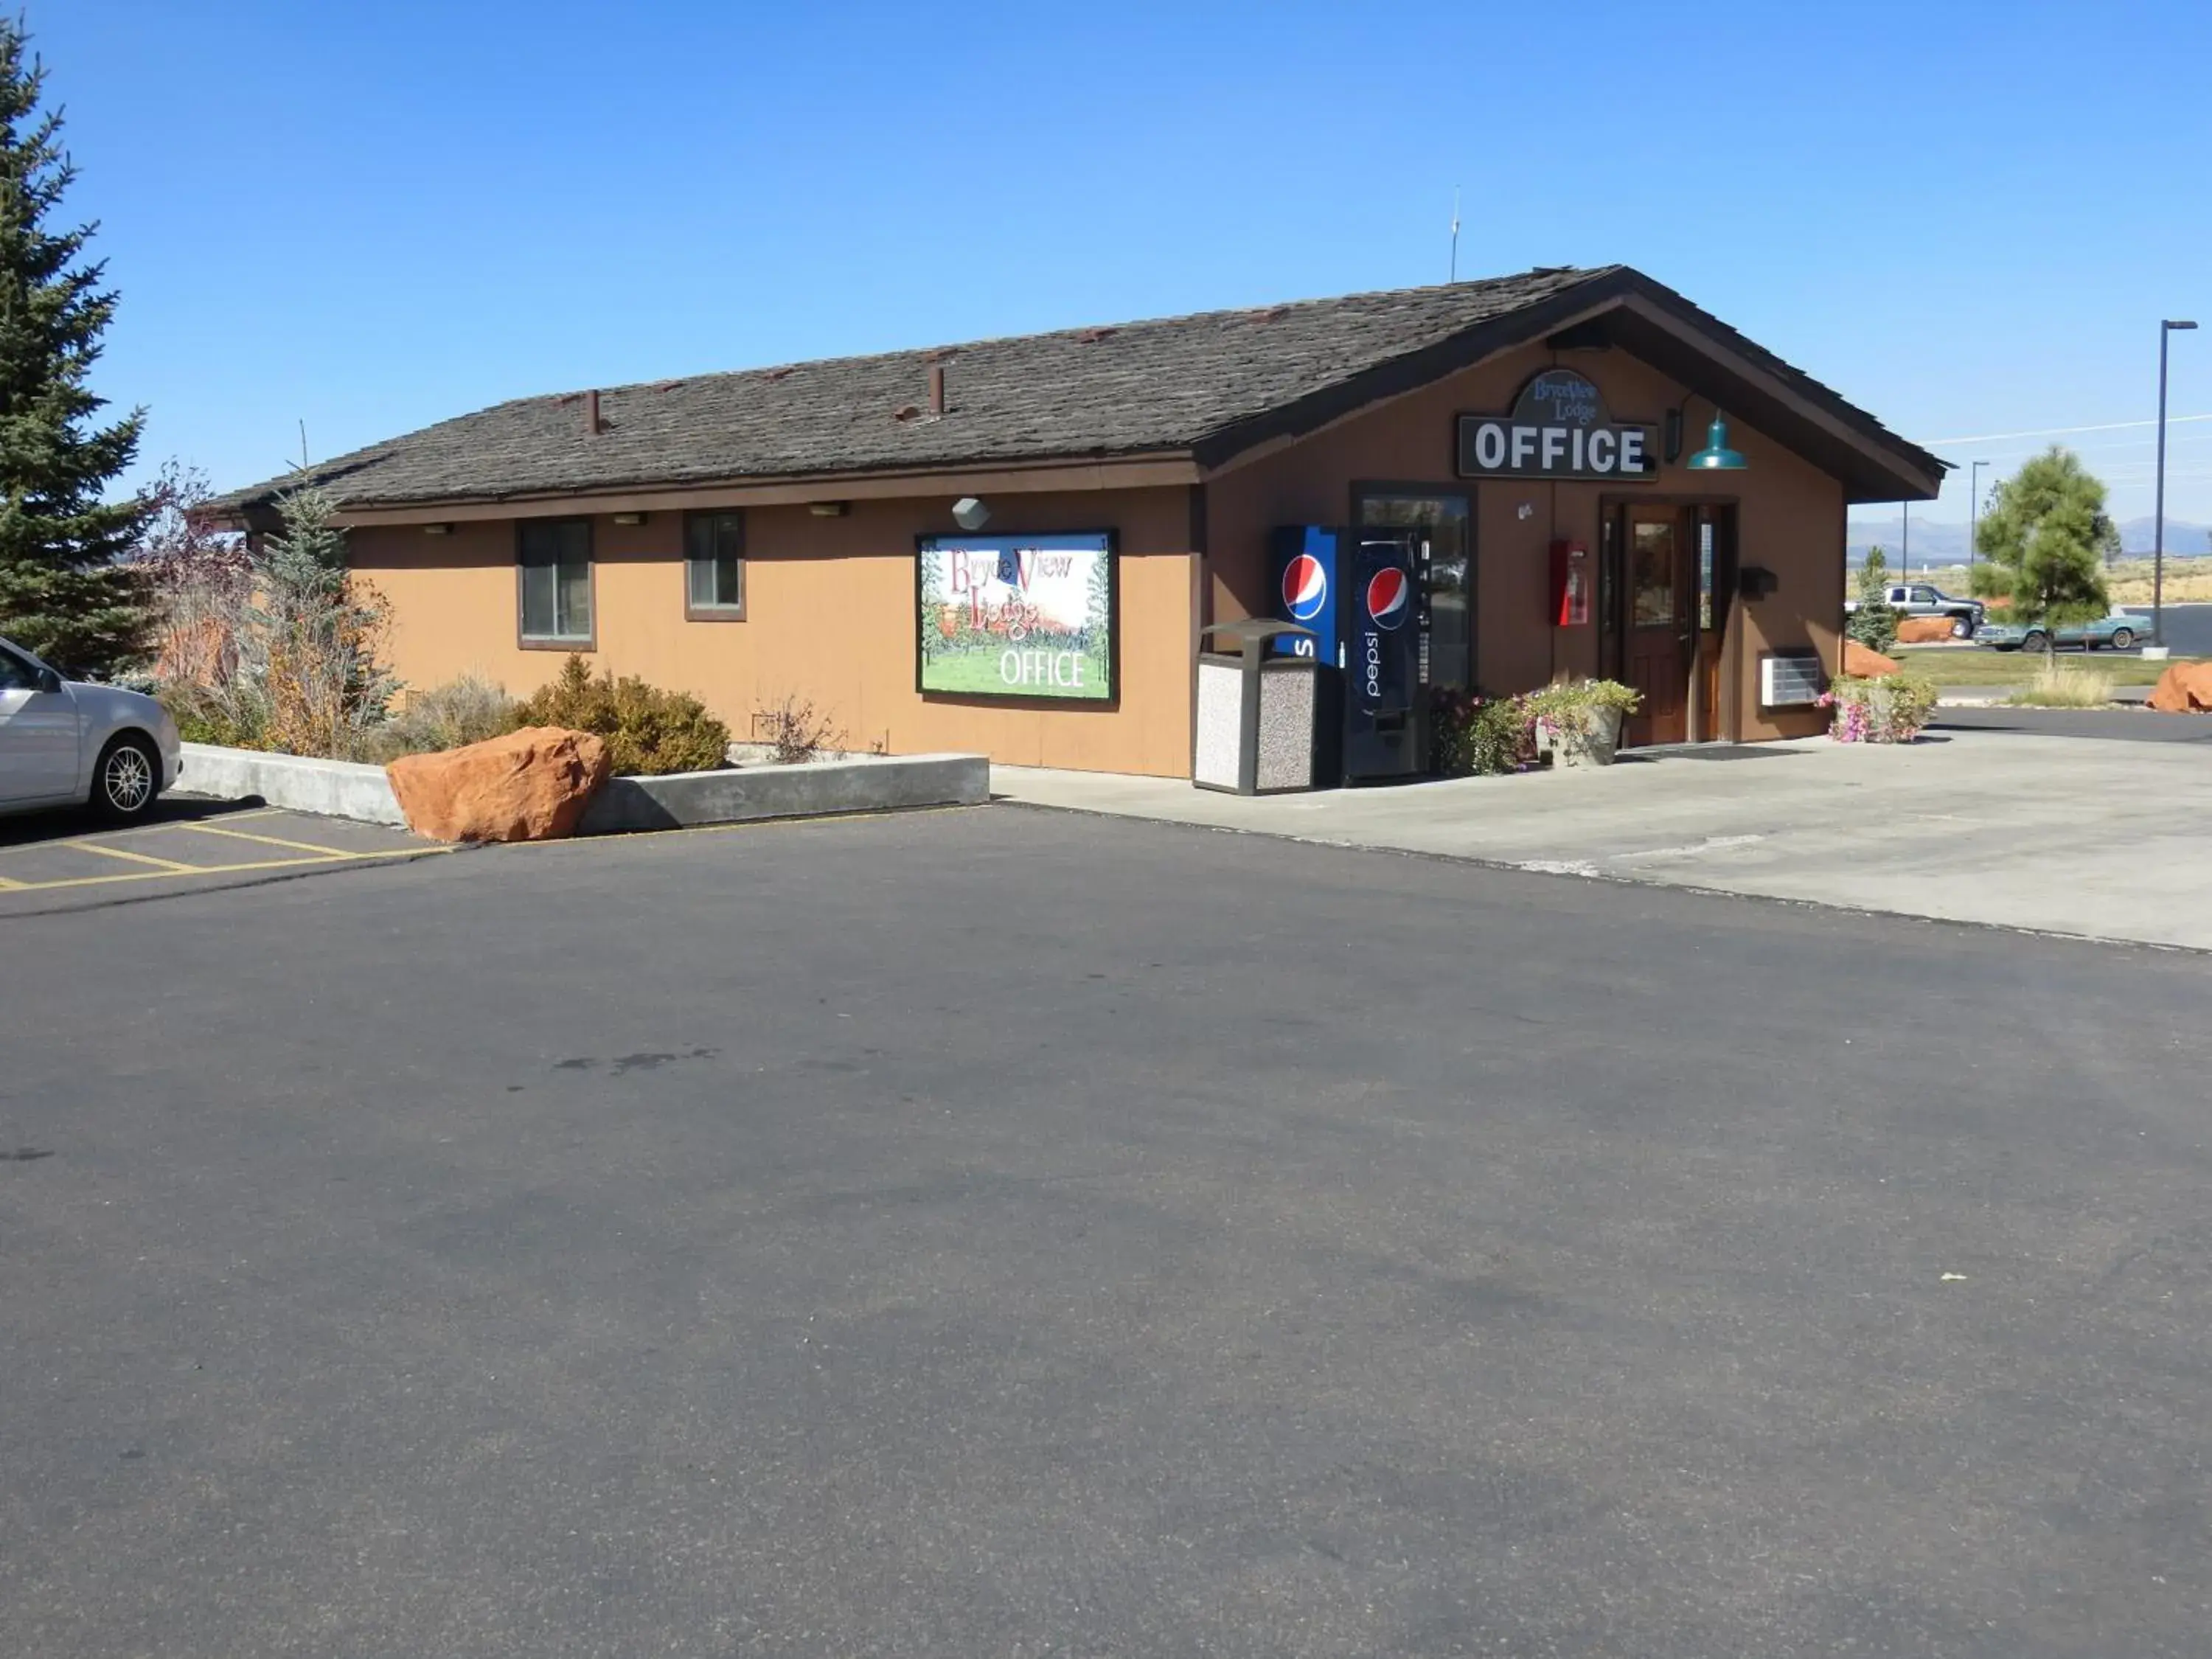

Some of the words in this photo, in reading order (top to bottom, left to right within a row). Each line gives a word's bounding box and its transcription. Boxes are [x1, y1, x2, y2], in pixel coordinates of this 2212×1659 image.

[1554, 399, 1597, 425] Lodge
[1475, 422, 1645, 473] OFFICE
[950, 548, 1012, 594] Bryce
[1012, 547, 1074, 593] View
[969, 585, 1038, 641] Lodge
[1000, 650, 1085, 687] OFFICE
[1365, 631, 1381, 698] pepsi
